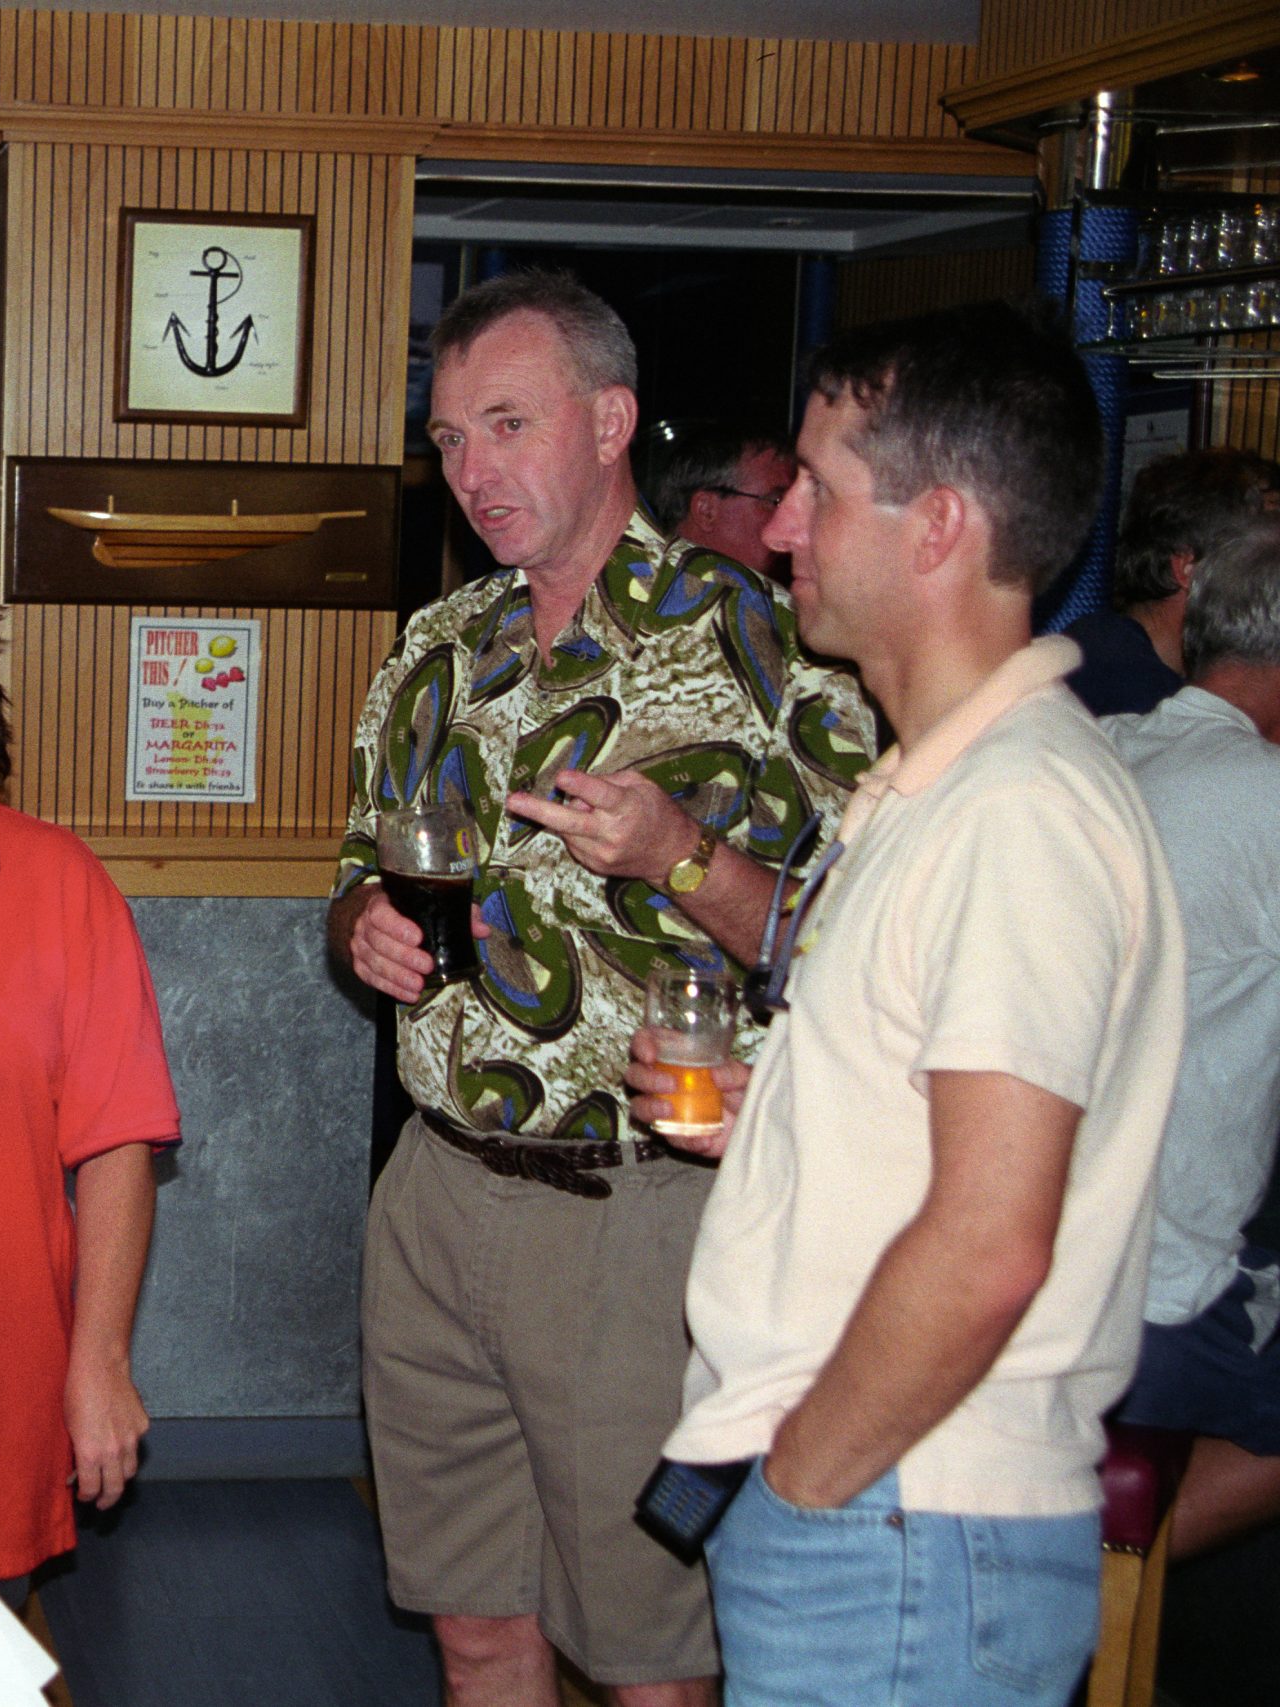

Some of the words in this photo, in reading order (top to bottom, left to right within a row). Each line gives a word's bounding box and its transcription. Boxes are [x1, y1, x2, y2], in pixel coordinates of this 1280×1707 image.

[146, 630, 199, 657] PITCHER
[142, 697, 166, 710] Buy
[168, 699, 176, 708] a
[179, 698, 220, 710] Pitcher
[222, 699, 234, 712] of
[149, 717, 190, 730] BEER
[182, 731, 195, 739] or
[145, 740, 237, 752] MARGARITA
[145, 766, 201, 778] Strawberry
[148, 781, 175, 790] share
[185, 781, 207, 790] with
[208, 781, 241, 792] friends
